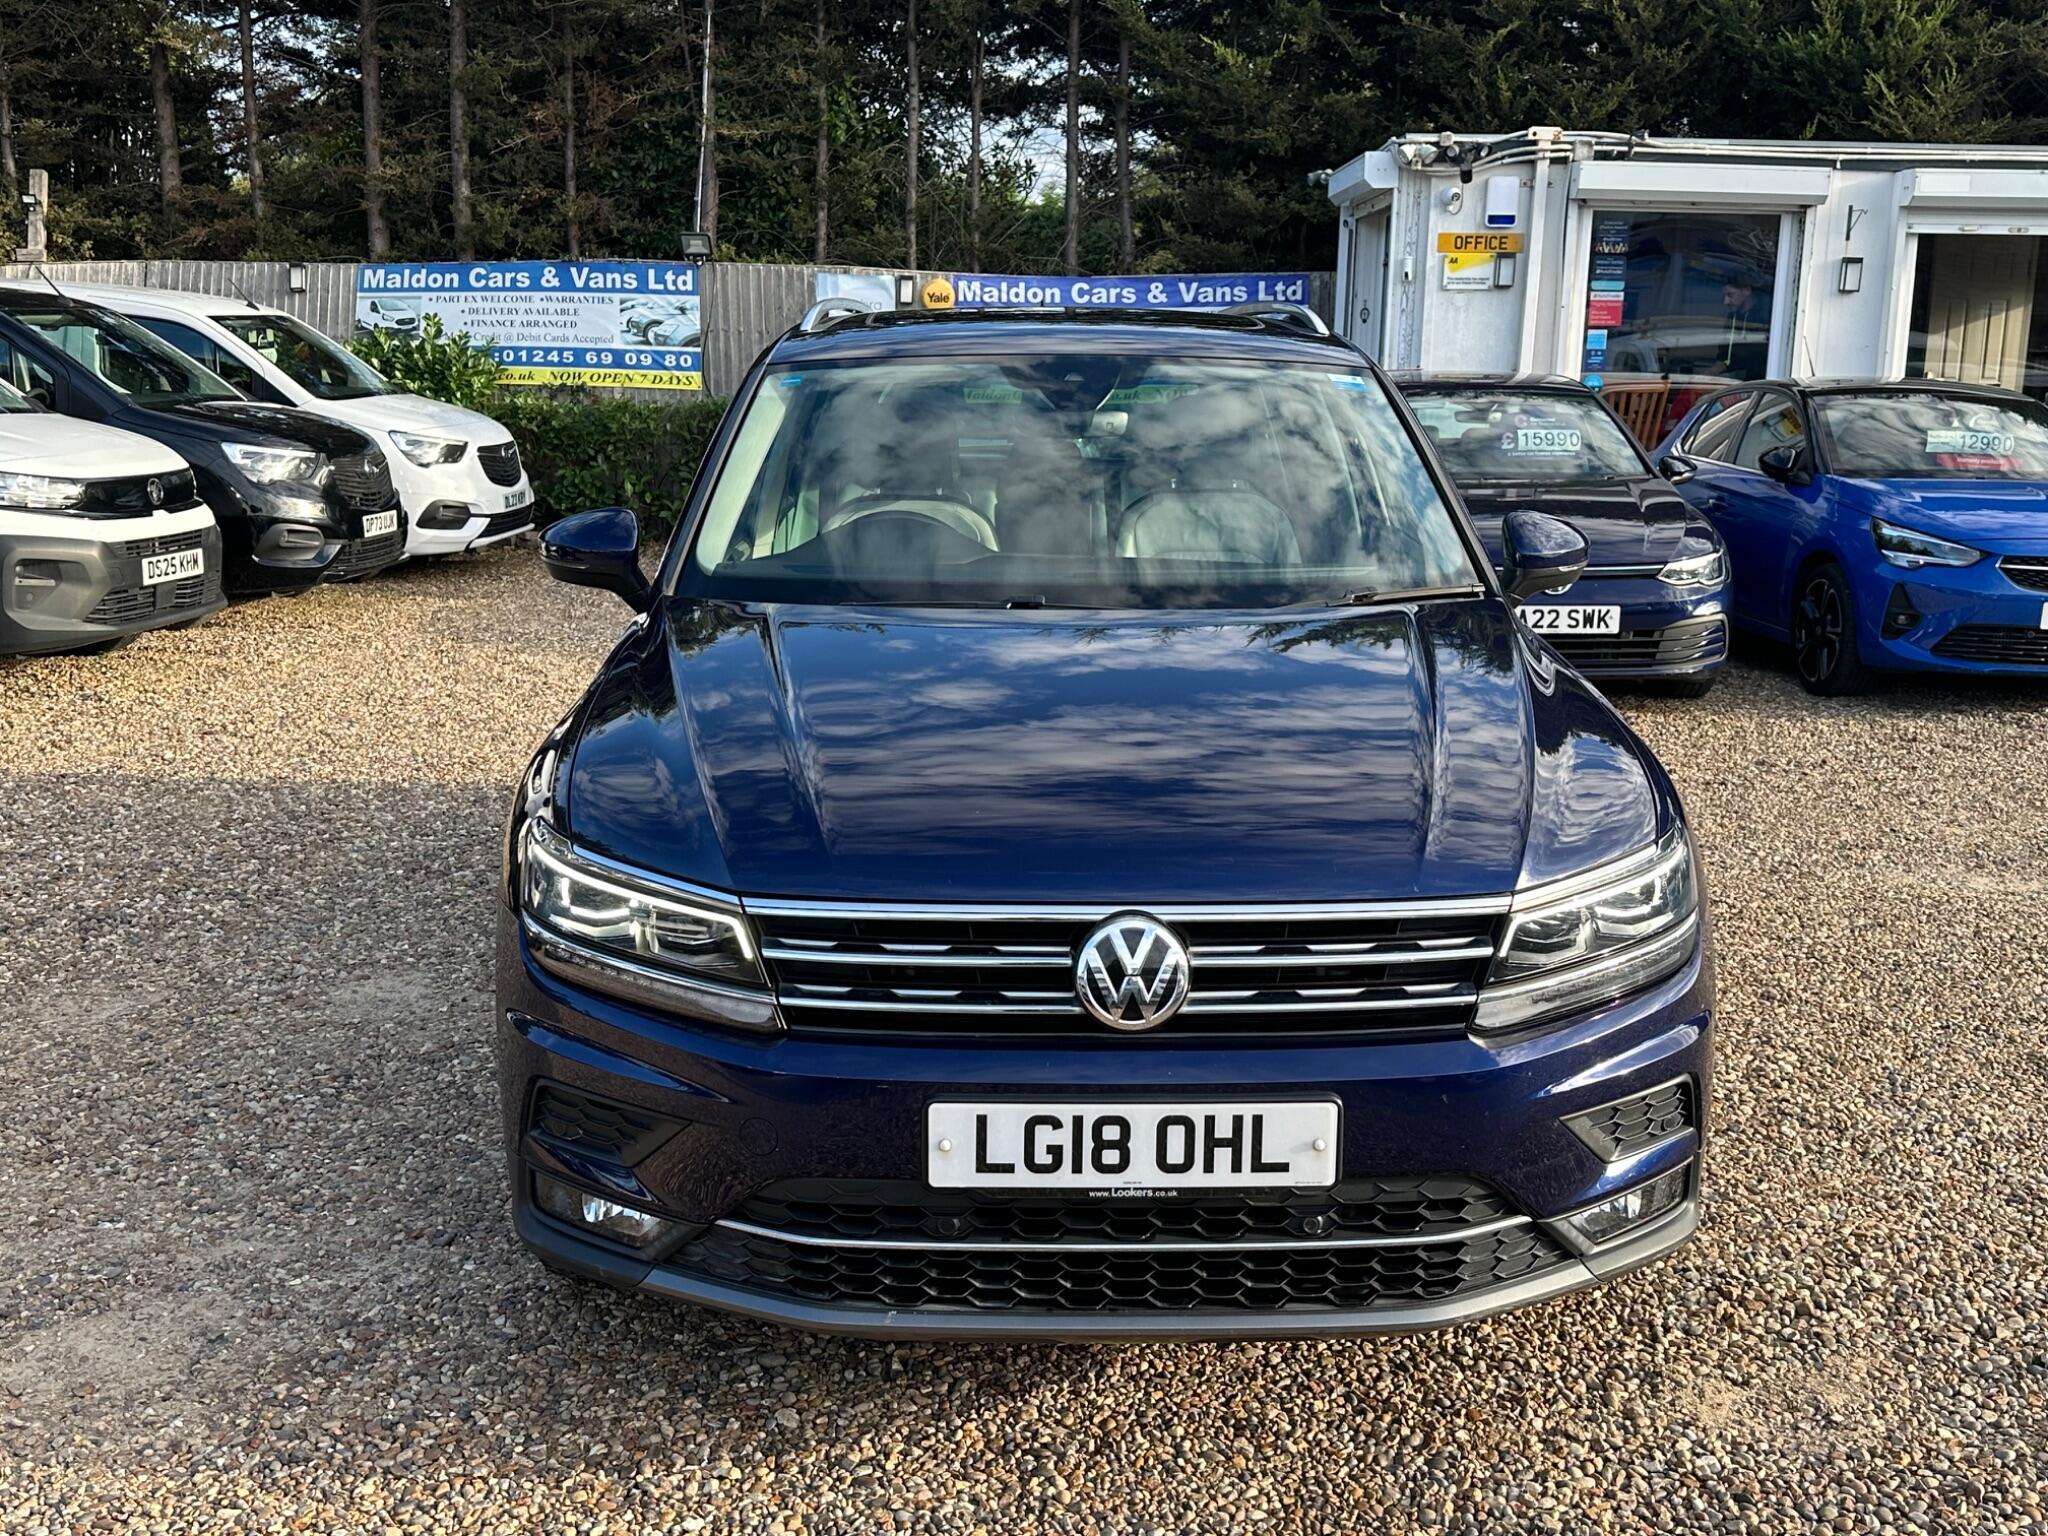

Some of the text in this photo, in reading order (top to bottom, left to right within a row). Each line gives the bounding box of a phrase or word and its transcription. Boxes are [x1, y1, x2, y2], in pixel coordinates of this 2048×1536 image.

[1454, 235, 1509, 251] OFFICE
[363, 266, 693, 291] Maldon Cars & Vans Ltd
[435, 295, 461, 304] PART
[464, 295, 479, 304] EX
[480, 295, 534, 304] WELCOME
[927, 292, 950, 304] Yale
[957, 279, 1303, 304] Maldon Cars & Vans Ltd
[468, 307, 580, 317] DELIVERY AVAILABLE
[471, 319, 577, 329] FINANCE ARRANGED
[473, 331, 501, 341] Credit
[504, 332, 514, 342] @
[516, 332, 542, 342] Debit
[544, 332, 570, 342] Cards
[572, 332, 614, 345] Accepted
[585, 351, 613, 365] 69
[625, 352, 653, 366] 09
[664, 354, 693, 367] 80
[547, 370, 586, 382] NOW
[589, 372, 635, 384] OPEN
[639, 373, 647, 384] 7
[651, 374, 694, 386] DAYS
[1521, 431, 1580, 447] 15990
[1960, 434, 2014, 452] 12990
[366, 516, 382, 533] DP73
[147, 551, 200, 580] DS25 KHM
[1567, 609, 1611, 629] SWK
[975, 1114, 1290, 1175] LG18 OHL
[1088, 1187, 1178, 1197] www.Lookers.co.uk
